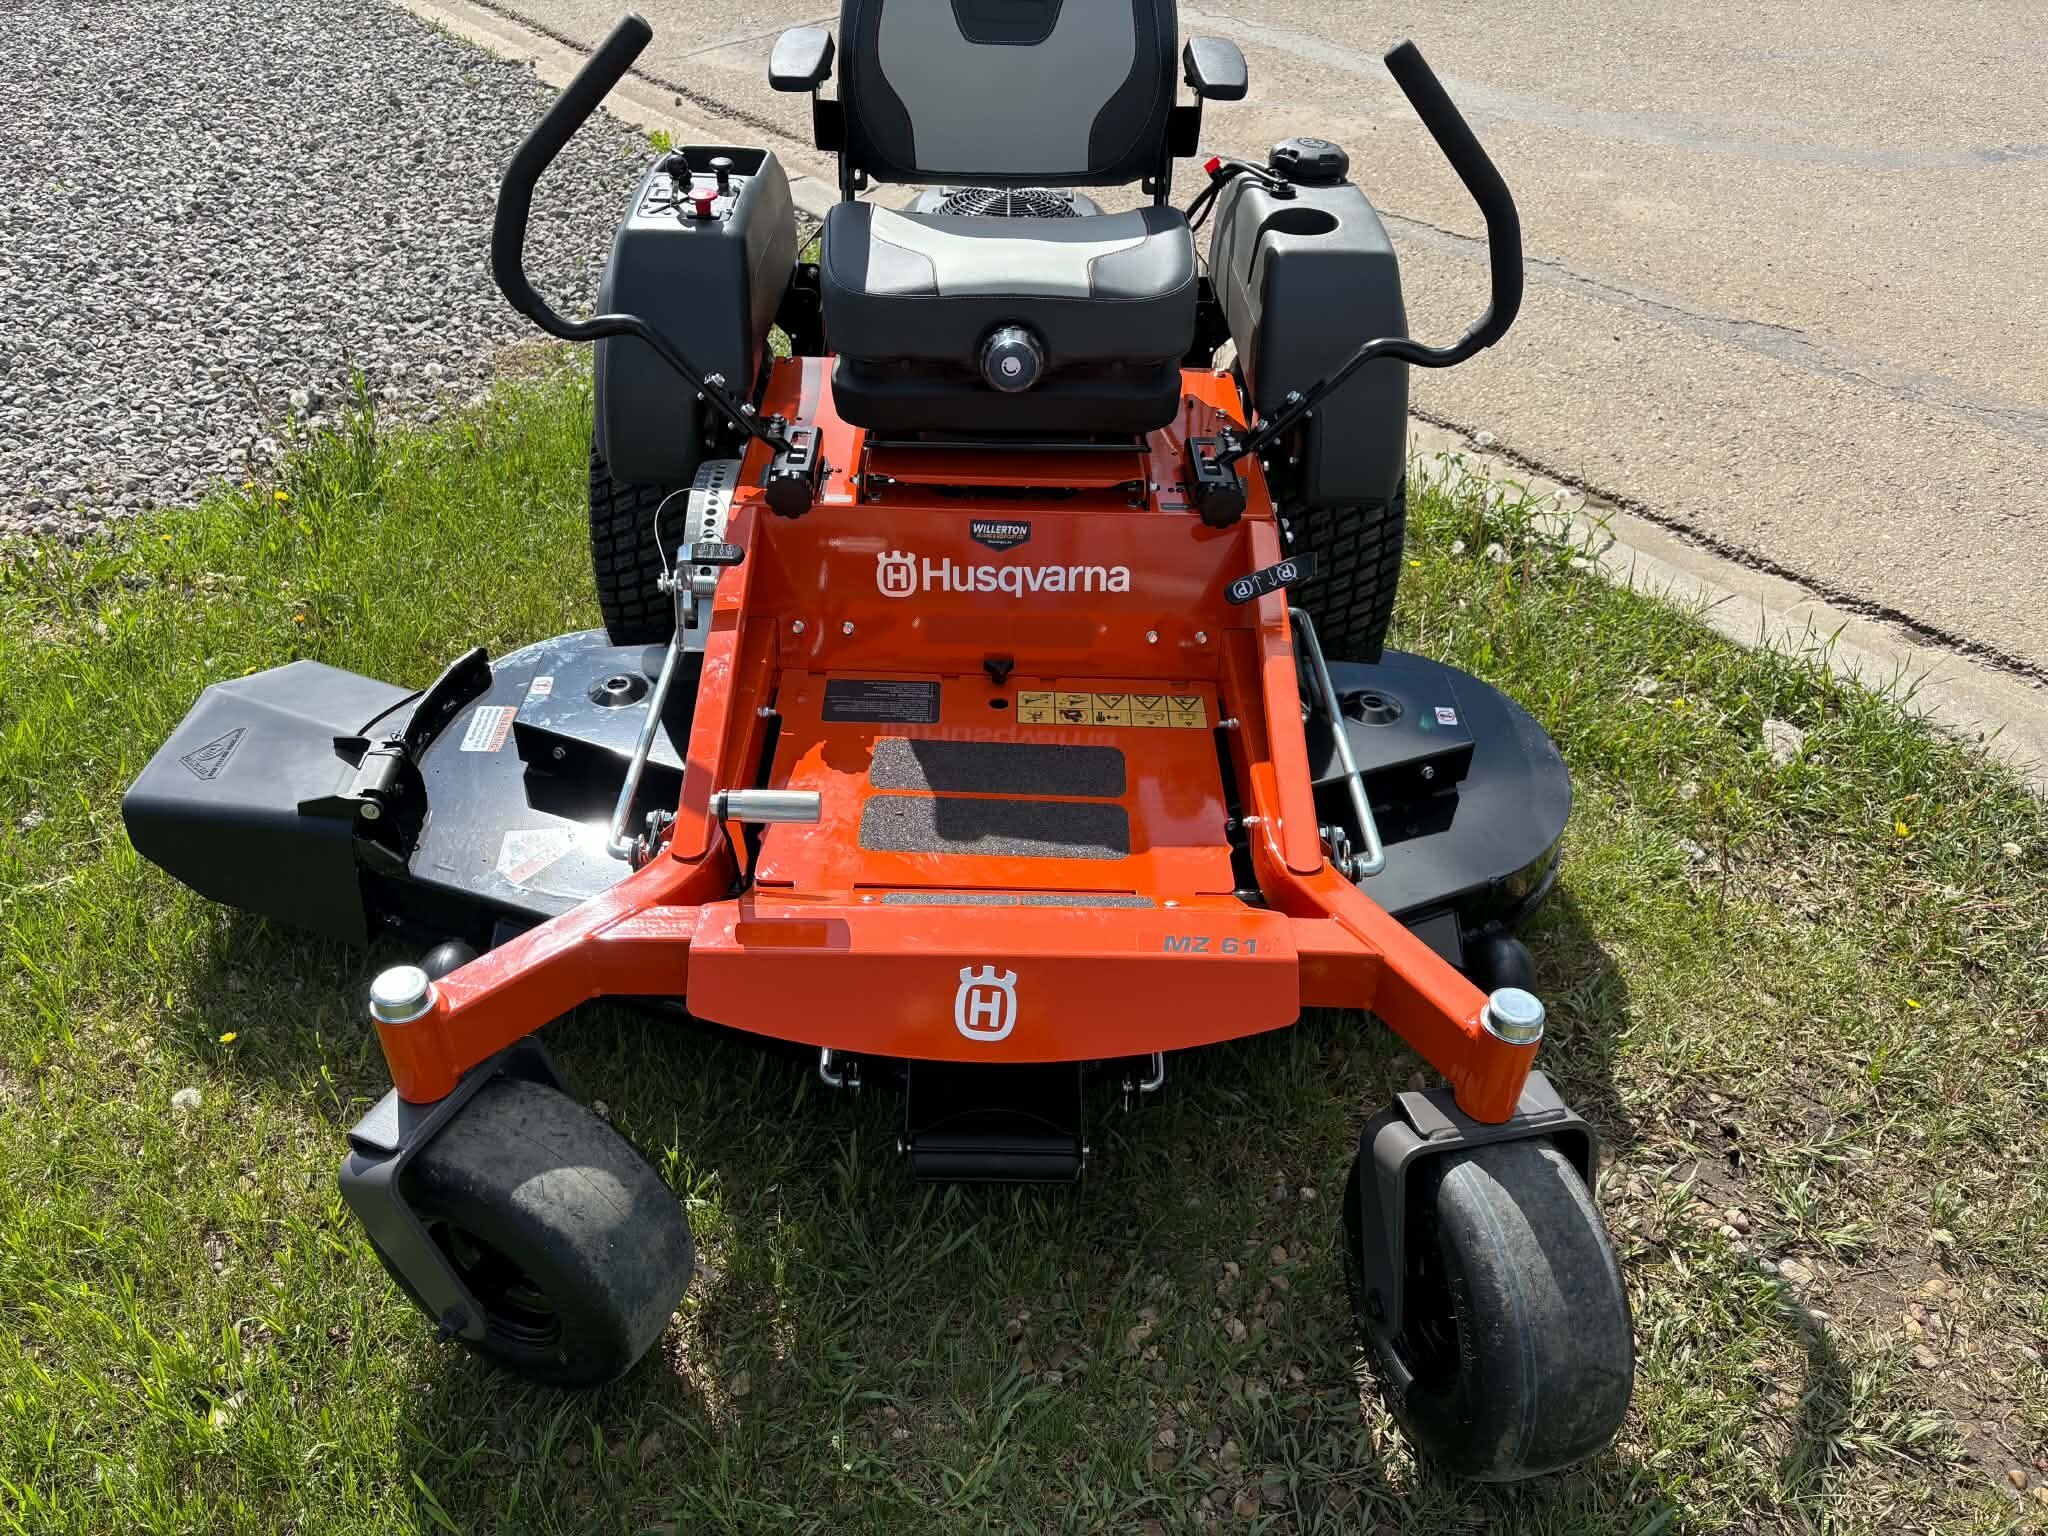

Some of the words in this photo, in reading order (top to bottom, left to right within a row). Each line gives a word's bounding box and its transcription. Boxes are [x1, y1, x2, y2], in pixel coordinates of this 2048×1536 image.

[973, 523, 1028, 535] WILLERTON
[922, 557, 1130, 598] Husqvarna
[1163, 935, 1210, 953] MZ
[1221, 937, 1257, 955] 61
